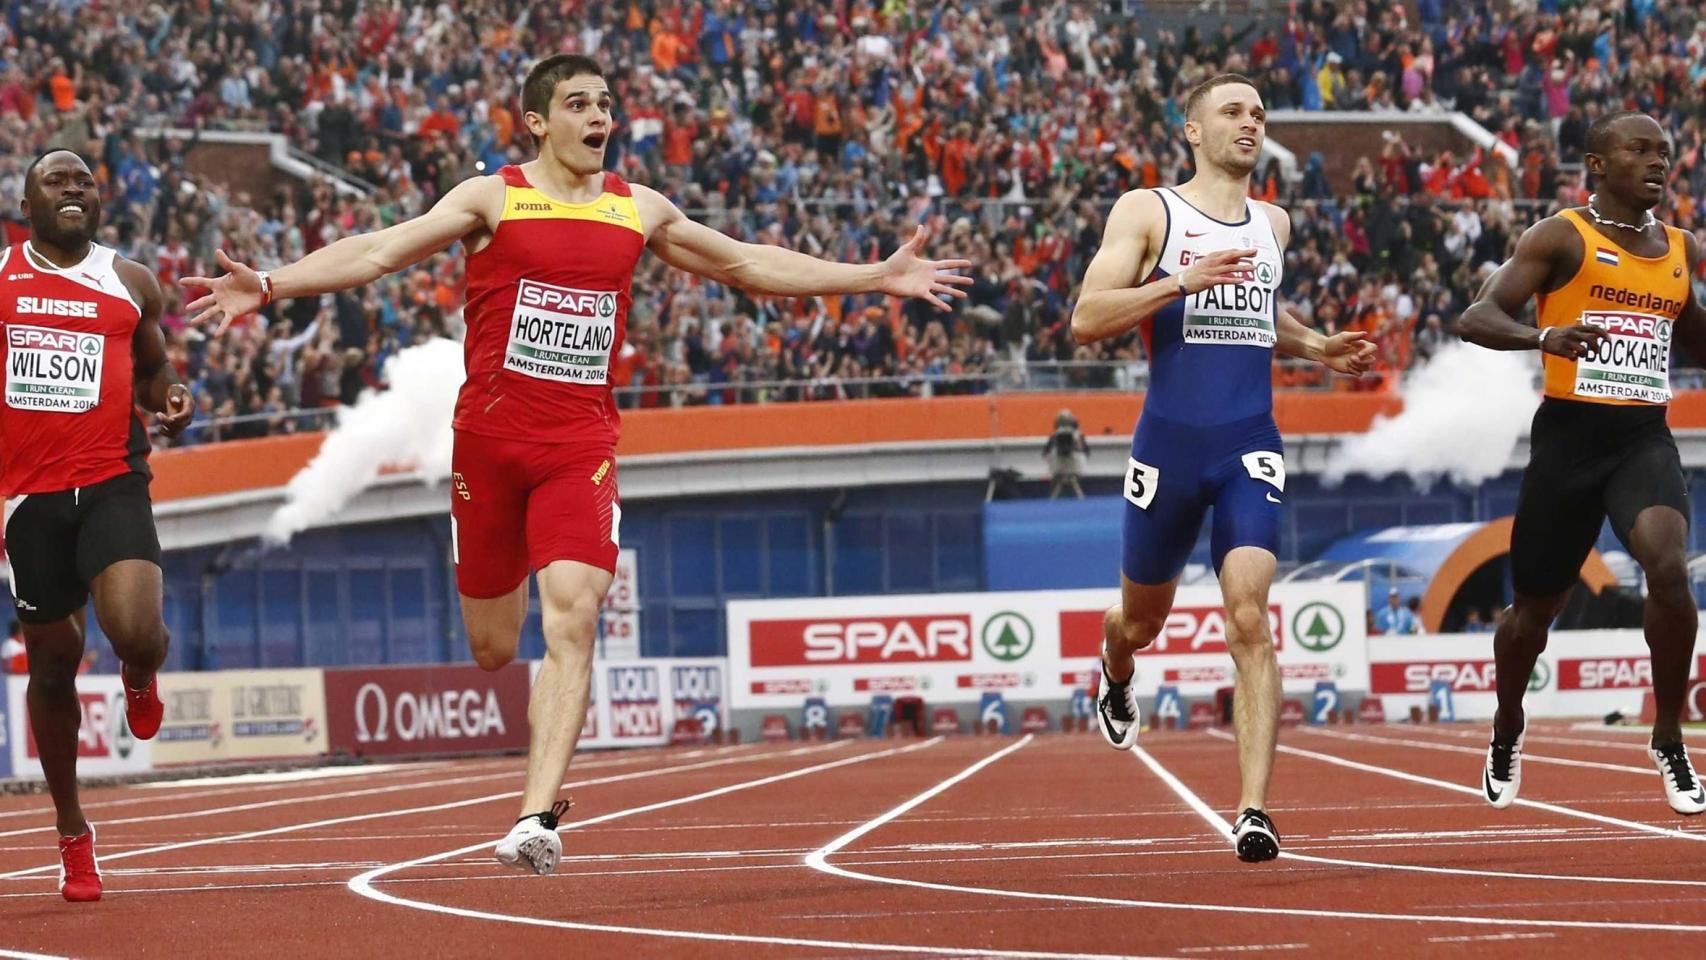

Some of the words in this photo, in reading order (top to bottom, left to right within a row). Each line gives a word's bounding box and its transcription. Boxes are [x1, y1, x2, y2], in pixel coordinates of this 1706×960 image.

[16, 296, 98, 318] SUISSE
[522, 285, 596, 314] SPAR
[515, 314, 612, 351] HORTELANO
[1213, 318, 1232, 326] RUN
[1233, 319, 1259, 328] CLEAN
[1586, 315, 1655, 336] SPAR
[10, 329, 76, 351] SPAR
[1185, 328, 1257, 341] AMSTERDAM
[1258, 333, 1276, 345] 2016
[13, 351, 97, 383] WILSON
[507, 356, 582, 379] AMSTERDAM
[585, 369, 605, 380] 2016
[539, 351, 559, 361] RUN
[561, 354, 590, 364] CLEAN
[30, 385, 47, 393] RUN
[48, 386, 76, 395] CLEAN
[1607, 373, 1627, 381] RUN
[1628, 375, 1653, 385] CLEAN
[8, 395, 70, 408] AMSTERDAM
[73, 400, 96, 410] 2016
[1577, 382, 1649, 399] AMSTERDAM
[1651, 391, 1671, 401] 2016
[1257, 457, 1276, 478] 5
[453, 472, 471, 500] ESP
[1131, 467, 1145, 498] 5
[803, 619, 970, 660] SPAR
[1156, 611, 1281, 651] PA
[982, 700, 1004, 728] 6
[1158, 694, 1181, 719] 4
[1316, 690, 1336, 721] 2
[1436, 687, 1451, 717] 1
[394, 688, 506, 741] OMEGA
